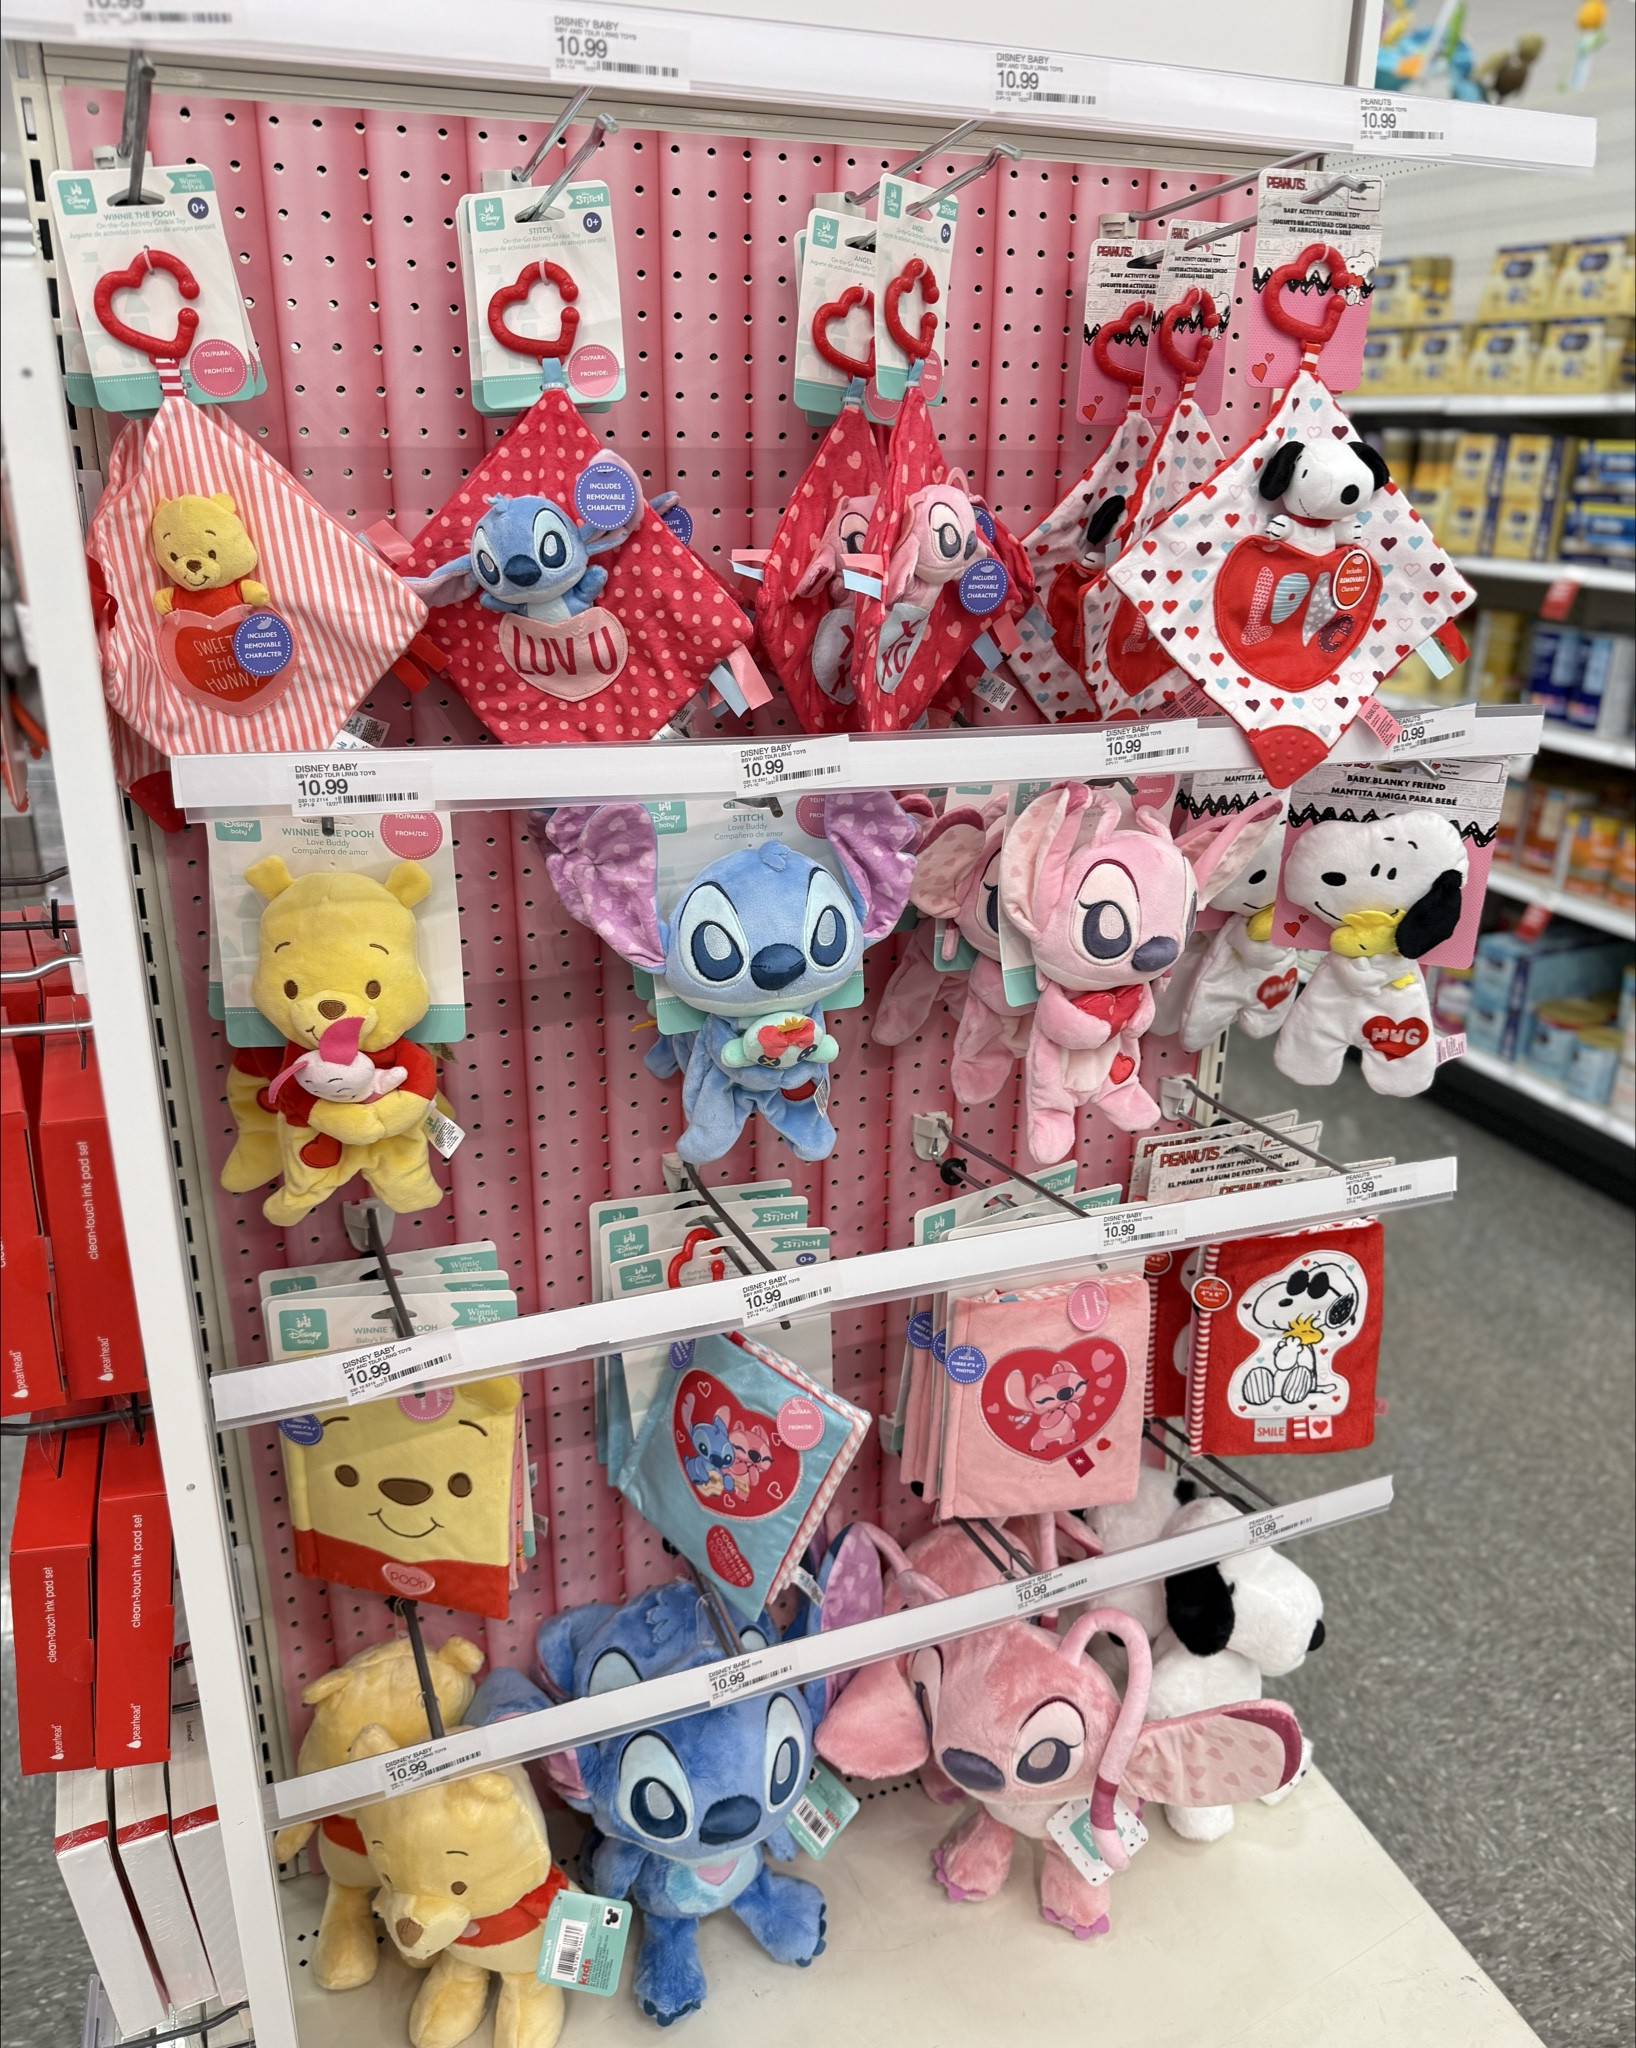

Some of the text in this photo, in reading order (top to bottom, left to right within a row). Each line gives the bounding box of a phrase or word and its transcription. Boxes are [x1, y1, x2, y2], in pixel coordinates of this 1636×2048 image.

[554, 16, 619, 31] DISNEY BABY
[557, 36, 608, 59] 10.99
[997, 53, 1049, 64] DISNEY BABY
[998, 70, 1039, 89] 10.99
[1361, 98, 1392, 106] PEANUTS
[1362, 113, 1396, 128] 10.99
[179, 177, 203, 186] Winnie
[188, 183, 206, 191] Pooh
[64, 194, 91, 206] Disney
[575, 193, 604, 205] STITCH
[191, 202, 205, 214] 0+
[103, 209, 176, 221] WINNIE THE POOH
[479, 212, 500, 223] Disney
[176, 217, 186, 226] Toy
[586, 217, 599, 227] 0+
[1305, 220, 1334, 228] ACTIVIDAD
[528, 226, 553, 235] STITCH
[815, 230, 834, 241] Disney
[943, 229, 950, 237] 0+
[854, 256, 872, 265] ANGEL
[202, 350, 231, 358] TO/PARA:
[204, 367, 235, 375] FROM/DE:
[586, 493, 626, 501] REMOVABLE
[244, 641, 282, 649] REMOVABLE
[513, 625, 618, 676] LUV U
[245, 651, 282, 659] CHARACTER
[205, 671, 260, 693] HUNNY
[1106, 728, 1131, 737] DISNEY
[1397, 726, 1424, 743] 10.99
[741, 744, 792, 757] DISNEY BABY
[1107, 739, 1142, 756] 10.99
[295, 763, 358, 773] DISNEY BABY
[743, 759, 785, 778] 10.99
[1225, 774, 1260, 782] MANTITA
[1347, 774, 1446, 791] BABY BLANKY FRIEND
[298, 778, 349, 796] 10.99
[1331, 787, 1458, 806] MANTITA AMIGA PARA BEBÉ
[651, 812, 681, 822] Disney
[732, 814, 765, 823] STITCH
[282, 828, 375, 838] WINNIE POOH
[728, 823, 768, 831] Love Buddy
[714, 832, 754, 841] Compañero
[306, 838, 350, 848] Love Buddy
[292, 846, 336, 856] Compañero
[337, 847, 348, 855] de
[1371, 1027, 1421, 1046] HUG
[1160, 1146, 1220, 1168] PEANUTS
[1191, 1161, 1235, 1174] BABY'S FIRST
[1177, 1176, 1205, 1187] PRIMER
[1206, 1171, 1230, 1182] ÁLBUM
[1241, 1167, 1264, 1176] FOTOS
[1346, 1172, 1370, 1180] PEANUTS
[1347, 1181, 1374, 1196] 10.99
[76, 1141, 98, 1260] clean-touch ink pad set
[763, 1211, 799, 1223] STITCH
[1103, 1214, 1125, 1222] DISNEY
[1105, 1223, 1135, 1238] 10.99
[615, 1243, 644, 1254] Disney
[783, 1239, 821, 1249] STITCH
[450, 1259, 480, 1268] Winnie
[621, 1272, 656, 1282] Disney
[743, 1275, 787, 1294] DISNEY BABY
[746, 1289, 782, 1310] 10.99
[467, 1307, 499, 1317] Winnie
[478, 1314, 501, 1324] Pooh
[285, 1327, 322, 1341] Disney
[354, 1327, 388, 1335] WINNIE
[297, 1338, 316, 1346] baby
[100, 1338, 111, 1373] pearhead
[343, 1345, 396, 1369] DISNEY BABY
[12, 1352, 26, 1389] pearhead
[347, 1361, 391, 1386] 10.99
[1256, 1426, 1285, 1438] SMILE
[1249, 1515, 1272, 1525] PEANUTS
[1251, 1521, 1276, 1537] 10.99
[713, 1531, 747, 1586] TOGETHER
[719, 1529, 752, 1581] TOGETHER
[132, 1514, 144, 1628] clean-touch ink pad set
[390, 1571, 427, 1589] pooh
[1016, 1573, 1052, 1590] DISNEY BABY
[1018, 1584, 1046, 1601] 10.99
[43, 1566, 57, 1663] clean-touch ink pad set
[709, 1659, 750, 1677] DISNEY BABY
[712, 1672, 744, 1691] 10.99
[130, 1704, 142, 1739] pearhead
[52, 1725, 65, 1753] pearhead
[385, 1747, 432, 1768] DISNEY BABY
[389, 1760, 427, 1781] 10.99
